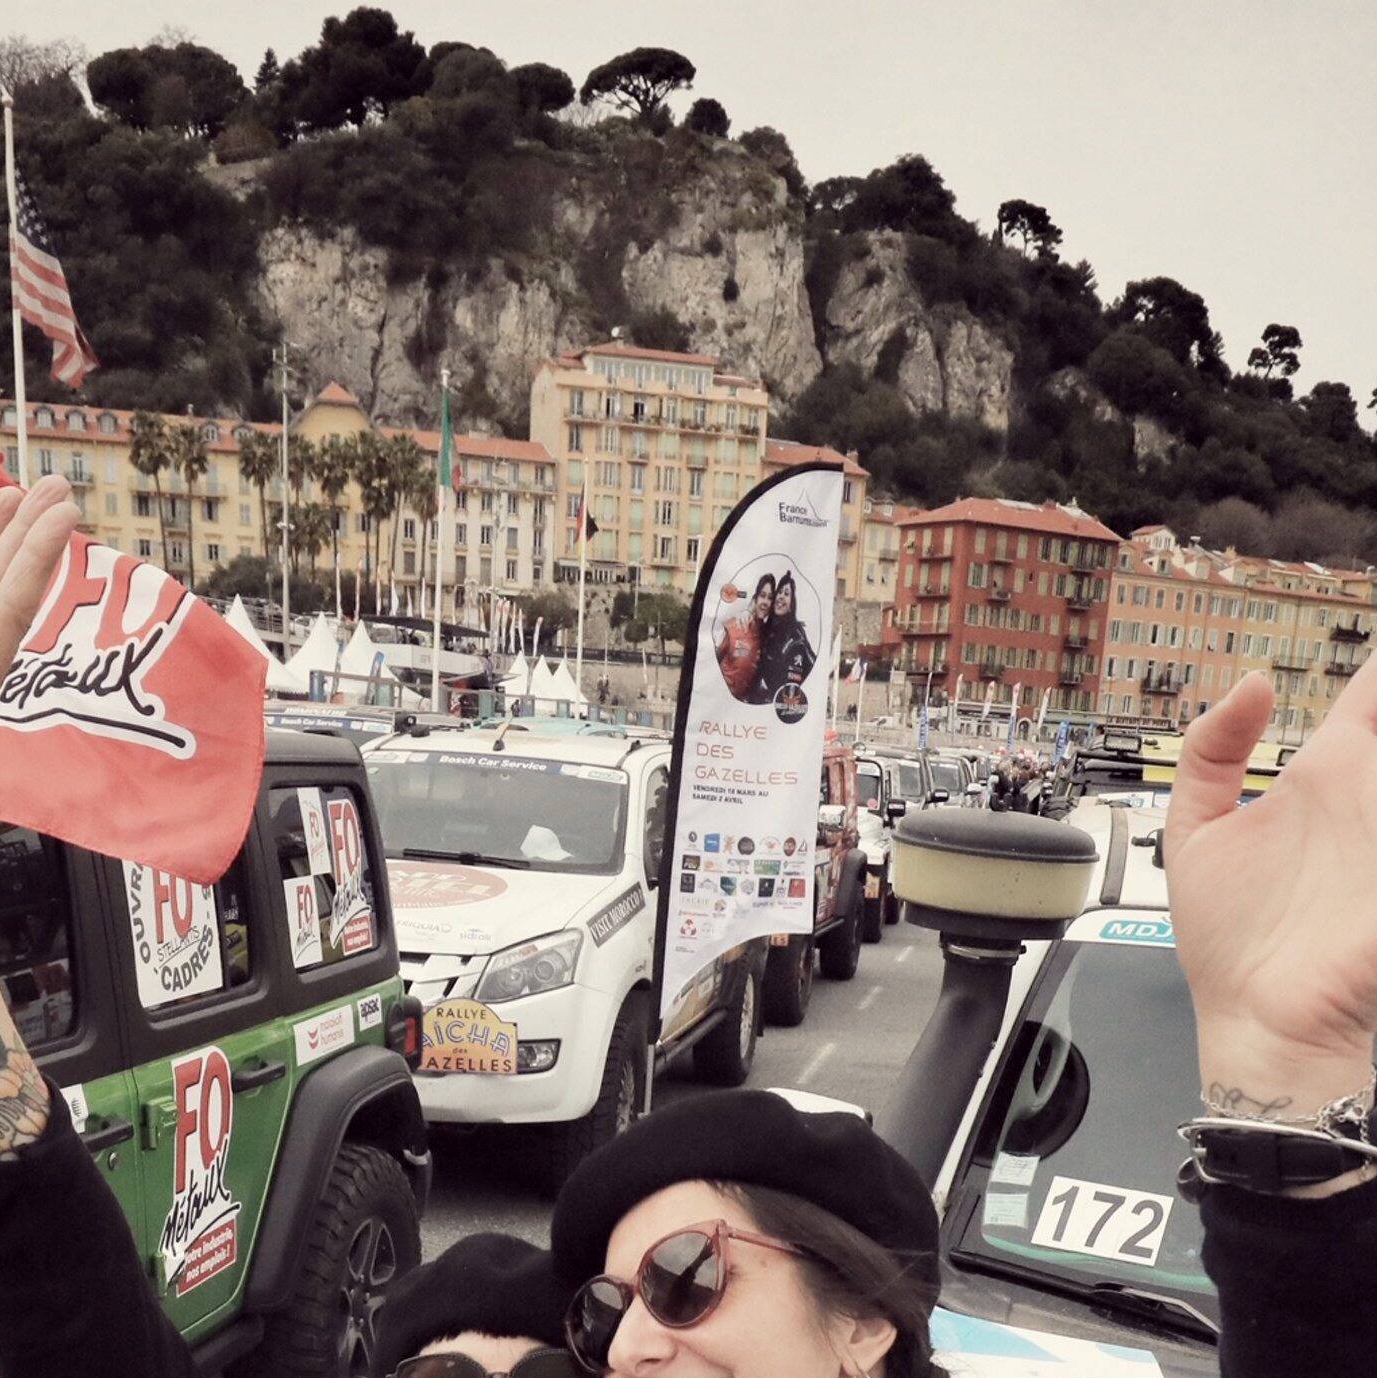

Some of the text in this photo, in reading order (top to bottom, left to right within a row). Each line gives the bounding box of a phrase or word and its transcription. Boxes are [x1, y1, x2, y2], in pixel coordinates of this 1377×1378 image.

[696, 742, 735, 760] DES
[699, 720, 767, 741] RALLYE
[438, 755, 548, 772] Bosch Car Service
[694, 764, 799, 786] GAZELLES
[328, 801, 361, 887] FO
[152, 864, 194, 944] FO
[296, 886, 313, 931] FO
[590, 888, 646, 941] VISIT MOROCCO
[160, 924, 213, 992] CADRES
[436, 1007, 487, 1020] RALLYE
[426, 1056, 513, 1073] AZELLES
[174, 1051, 231, 1195] FO
[1051, 1185, 1164, 1259] 172
